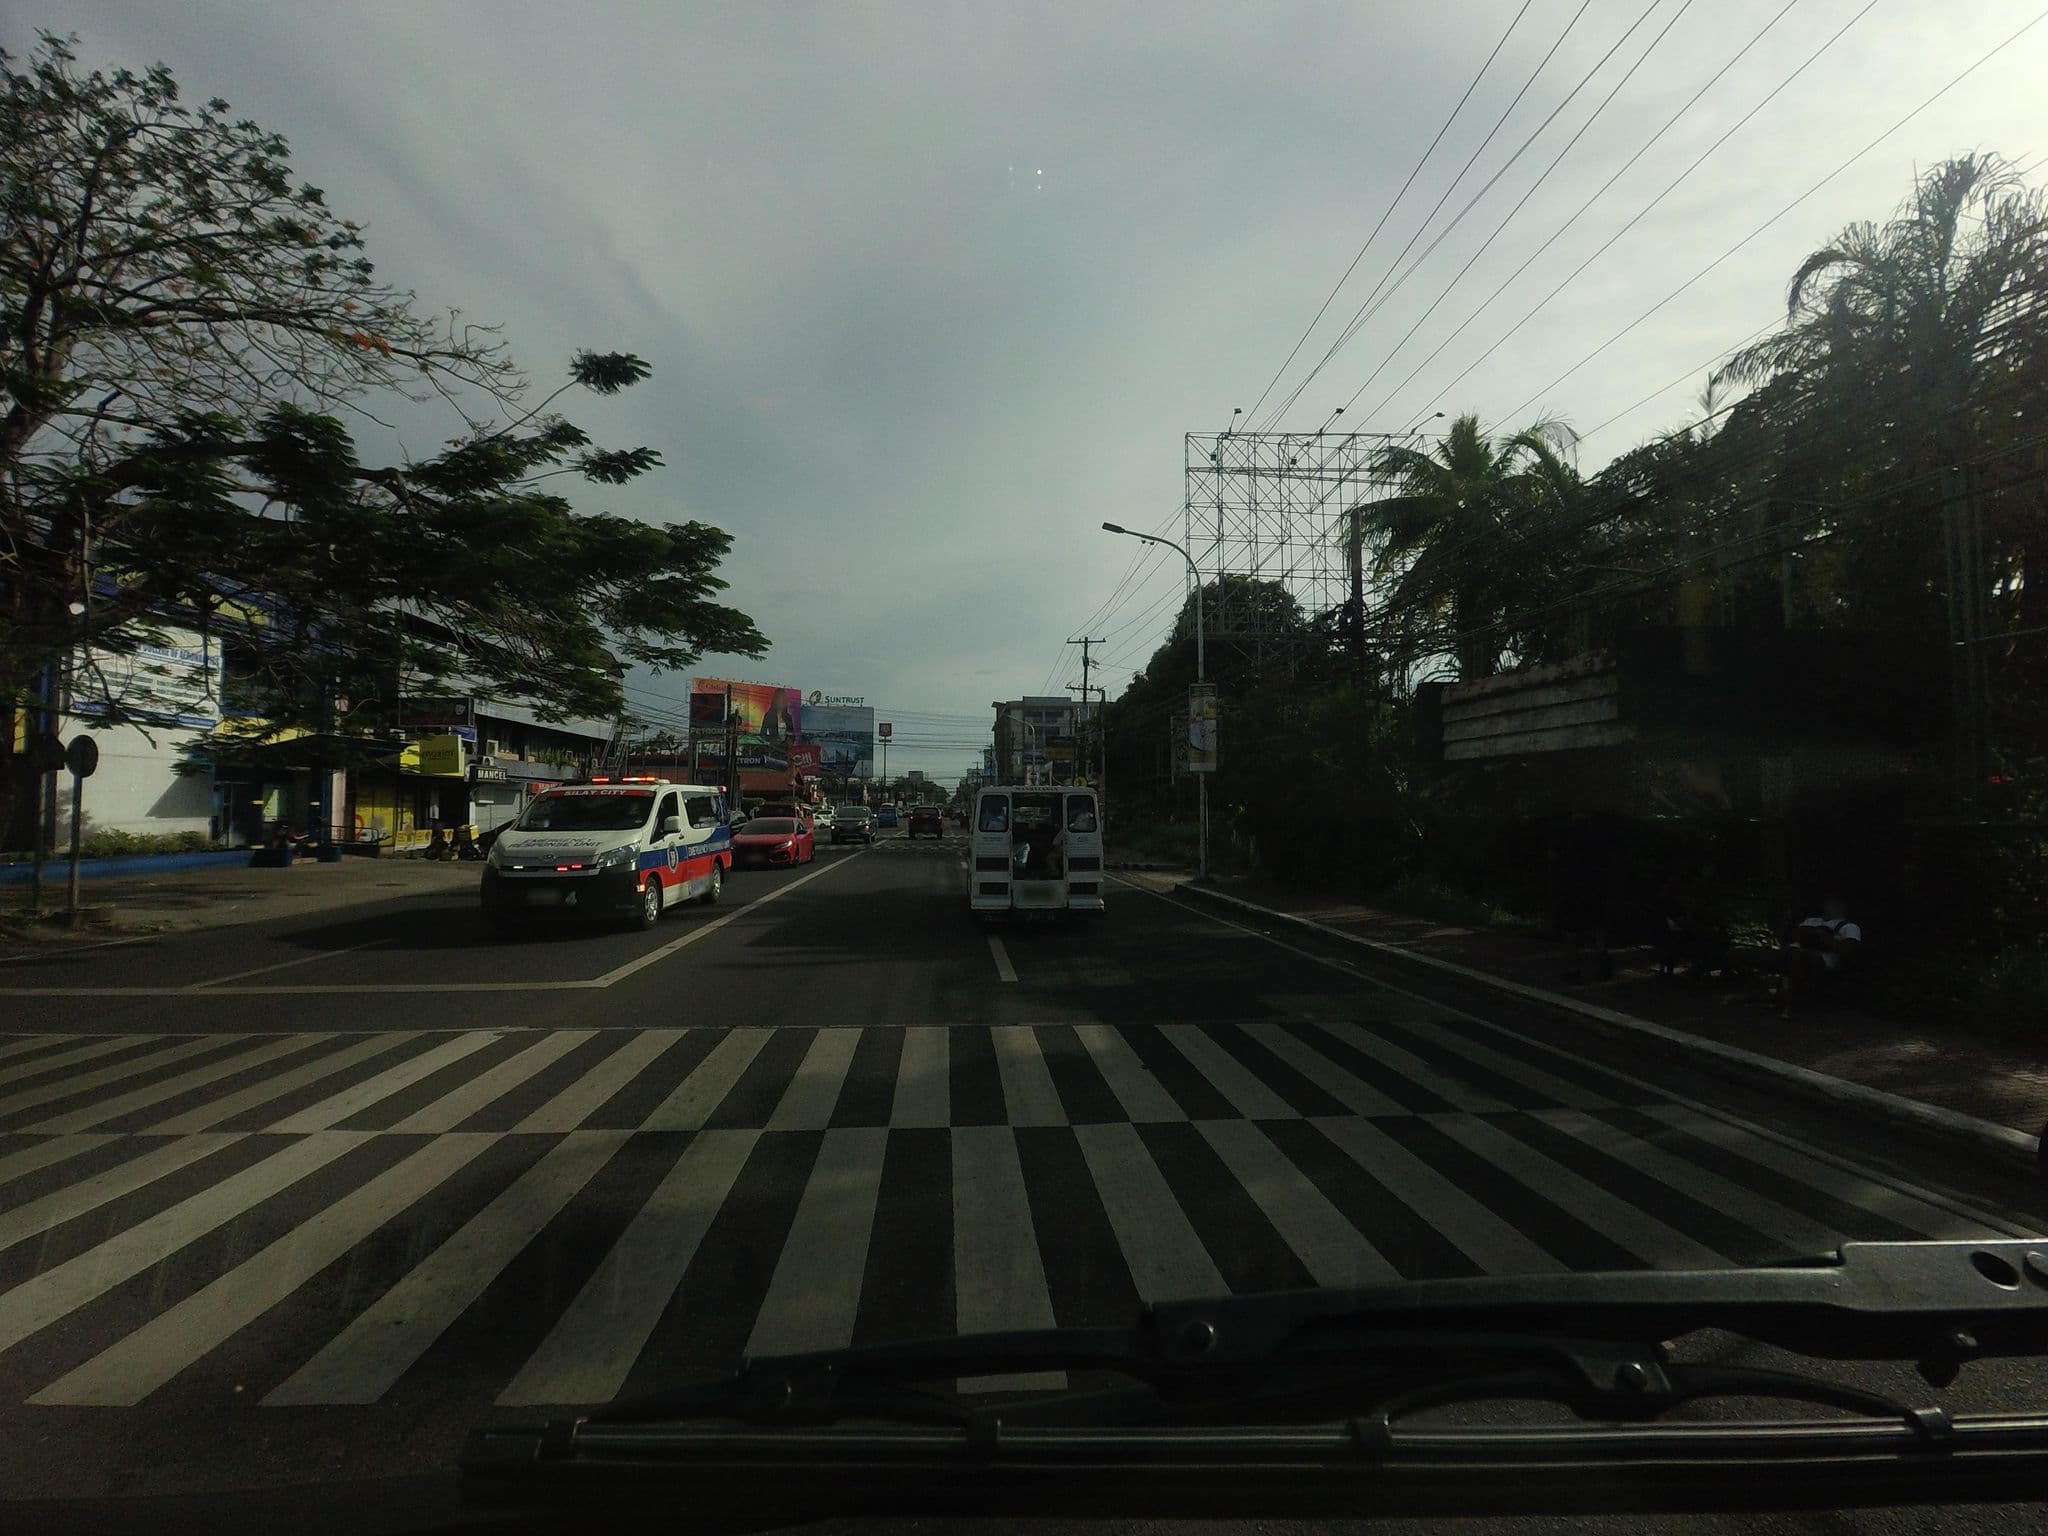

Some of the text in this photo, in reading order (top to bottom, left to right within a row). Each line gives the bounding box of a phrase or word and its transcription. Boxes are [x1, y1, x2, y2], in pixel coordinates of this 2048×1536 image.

[825, 695, 865, 704] SUNTRUST
[563, 789, 627, 797] SILAY CITY
